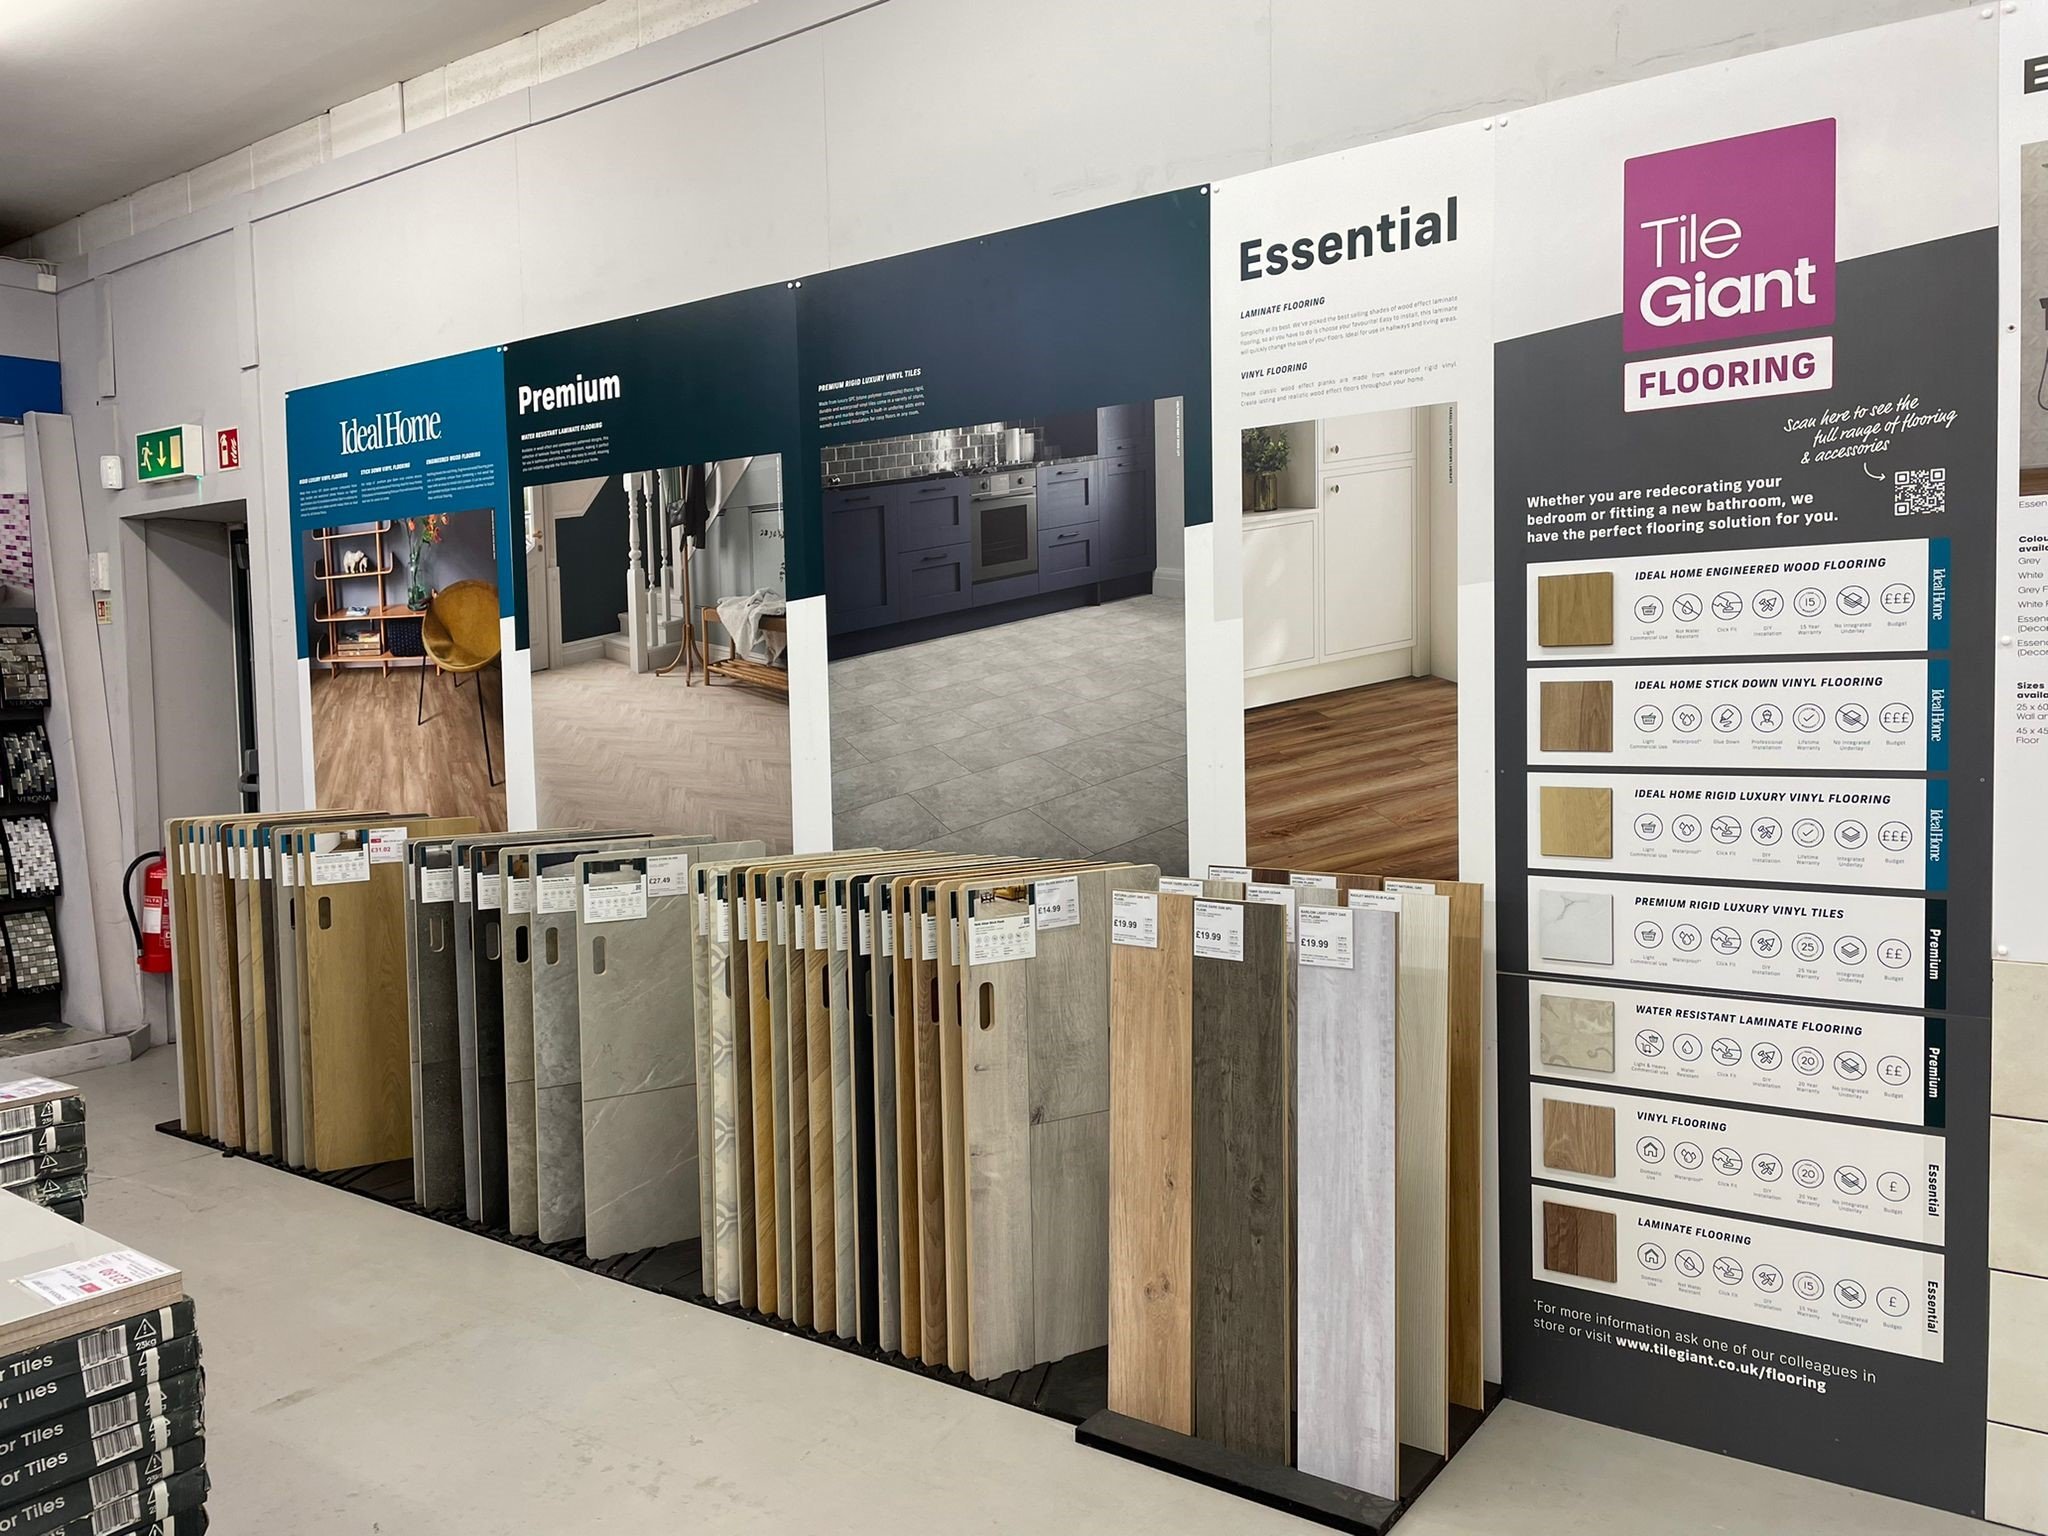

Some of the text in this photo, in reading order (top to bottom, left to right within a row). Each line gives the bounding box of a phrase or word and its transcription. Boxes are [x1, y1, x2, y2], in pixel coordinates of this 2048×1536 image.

[1240, 196, 1457, 282] Essential
[1641, 214, 1742, 268] Tile
[1640, 257, 1816, 326] Giant
[1240, 296, 1325, 319] LAMINATE FLOORING
[818, 368, 921, 392] PREMIUM RIGID LUXURY VINYL TILES
[1241, 362, 1308, 380] VINYL FLOORING
[1640, 352, 1815, 399] FLOORING
[518, 374, 620, 415] Premium
[1783, 394, 1919, 432] Scan here to see the
[339, 410, 442, 455] Ideal Home
[1813, 408, 1958, 448] full range of flooring
[1800, 438, 1890, 464] & accessories
[1527, 477, 1782, 508] Whether you are redecorating your
[1527, 494, 1814, 526] bedroom or fitting a new bathroom, we
[1527, 512, 1838, 543] have the perfect flooring solution for you.
[1635, 558, 1886, 580] IDEAL HOME ENGINEERED WOOD FLOORING
[2018, 557, 2040, 565] Grey
[1805, 597, 1816, 607] 15
[1885, 592, 1911, 605] £££
[1933, 568, 1946, 620] Ideal Home
[1635, 677, 1883, 690] IDEAL HOME STICK DOWN VINYL FLOORING
[1884, 712, 1908, 724] £££
[1931, 689, 1944, 742] Ideal Home
[2016, 703, 2028, 711] 25
[1635, 789, 1891, 804] IDEAL HOME RIGID LUXURY VINYL FLOORING
[1882, 830, 1908, 842] £££
[1930, 809, 1943, 862] Ideal Home
[1038, 904, 1061, 915] £14.99
[1635, 897, 1844, 919] PREMIUM RIGID LUXURY VINYL TILES
[1114, 919, 1137, 929] £19.99
[1196, 930, 1221, 941] £19.99
[1301, 938, 1329, 949] £19.99
[1801, 942, 1815, 952] 25
[1930, 929, 1941, 980] Premium
[1636, 1005, 1862, 1036] WATER RESISTANT LAMINATE FLOORING
[1801, 1056, 1815, 1066] 20
[1929, 1047, 1940, 1098] Premium
[1637, 1111, 1727, 1132] VINYL FLOORING
[1802, 1169, 1816, 1179] 20
[1928, 1163, 1939, 1217] Essential
[1638, 1217, 1751, 1245] LAMINATE FLOORING
[1803, 1281, 1814, 1291] 15
[1928, 1281, 1938, 1334] Essential
[1534, 1319, 1826, 1394] store or visit www.tilegiant.co.uk/flooring
[1560, 1308, 1592, 1322] more
[1593, 1312, 1670, 1339] information
[1675, 1332, 1698, 1346] ask
[1703, 1338, 1728, 1352] one
[1733, 1344, 1747, 1356] of
[1752, 1348, 1775, 1361] our
[1779, 1354, 1858, 1380] colleagues
[1863, 1369, 1876, 1384] in
[9, 1355, 54, 1377] Tiles
[20, 1424, 64, 1447] Tiles
[25, 1452, 68, 1476] Tiles
[22, 1497, 65, 1520] Tiles
